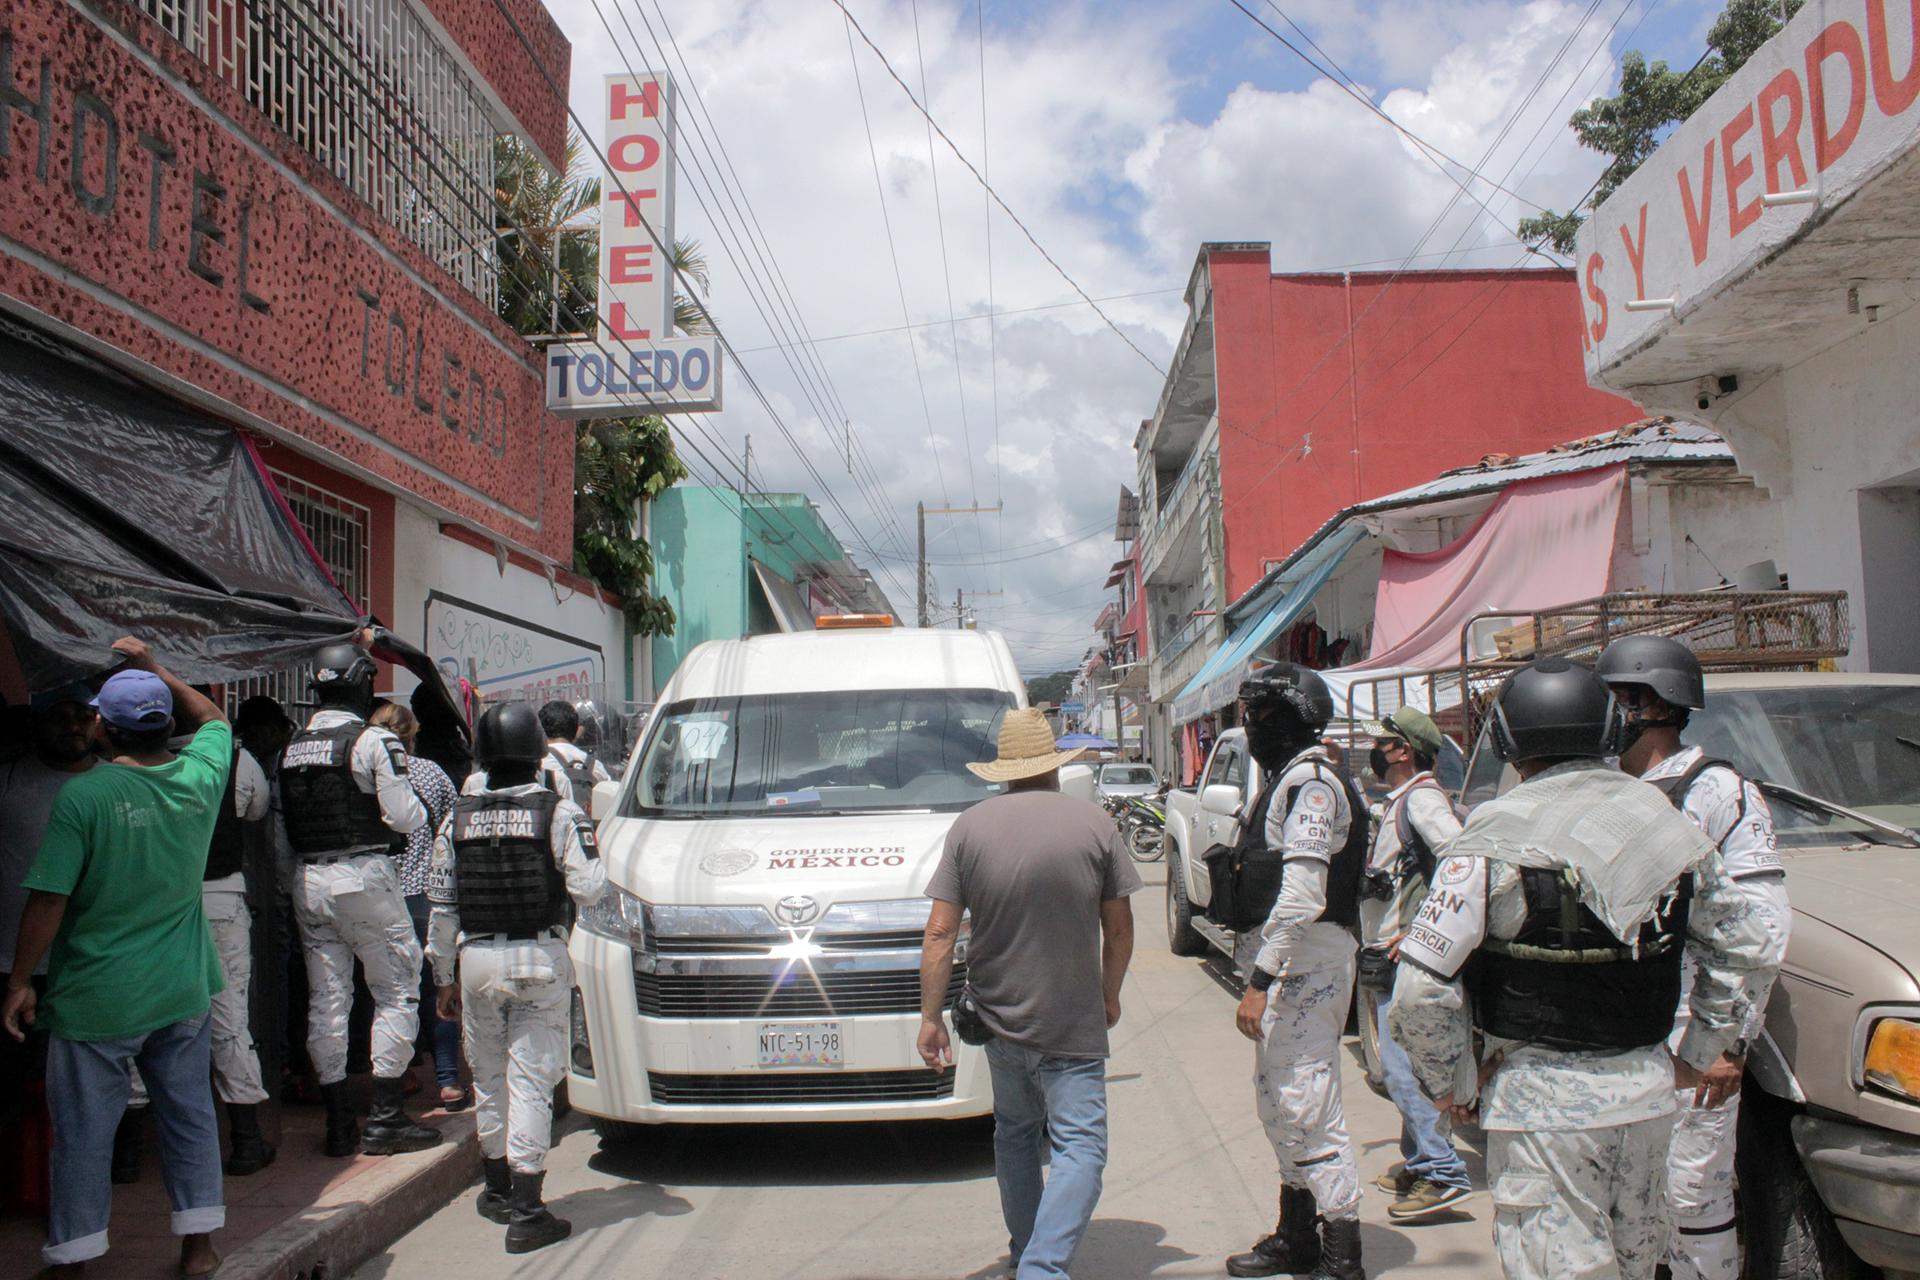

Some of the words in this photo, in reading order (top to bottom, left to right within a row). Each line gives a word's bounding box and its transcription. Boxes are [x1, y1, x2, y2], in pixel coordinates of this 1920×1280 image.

[607, 82, 660, 340] HOTEL
[0, 33, 270, 315] HOTEL
[357, 287, 507, 458] TOLEDO
[1619, 202, 1648, 301] Y
[551, 348, 710, 398] TOLEDO
[287, 740, 333, 756] GUARDIA
[283, 752, 333, 769] NACIONAL
[470, 810, 533, 825] GUARDIA
[1300, 814, 1332, 829] PLAN
[463, 823, 535, 839] NACIONAL
[1308, 827, 1327, 839] GN
[1752, 822, 1775, 838] PL
[770, 848, 873, 856] GOBIERNO
[880, 846, 905, 854] DE
[767, 854, 905, 870] MÉXICO
[1428, 887, 1465, 914] LAN
[1420, 904, 1443, 924] GN
[760, 1033, 839, 1053] NTC-51-98
